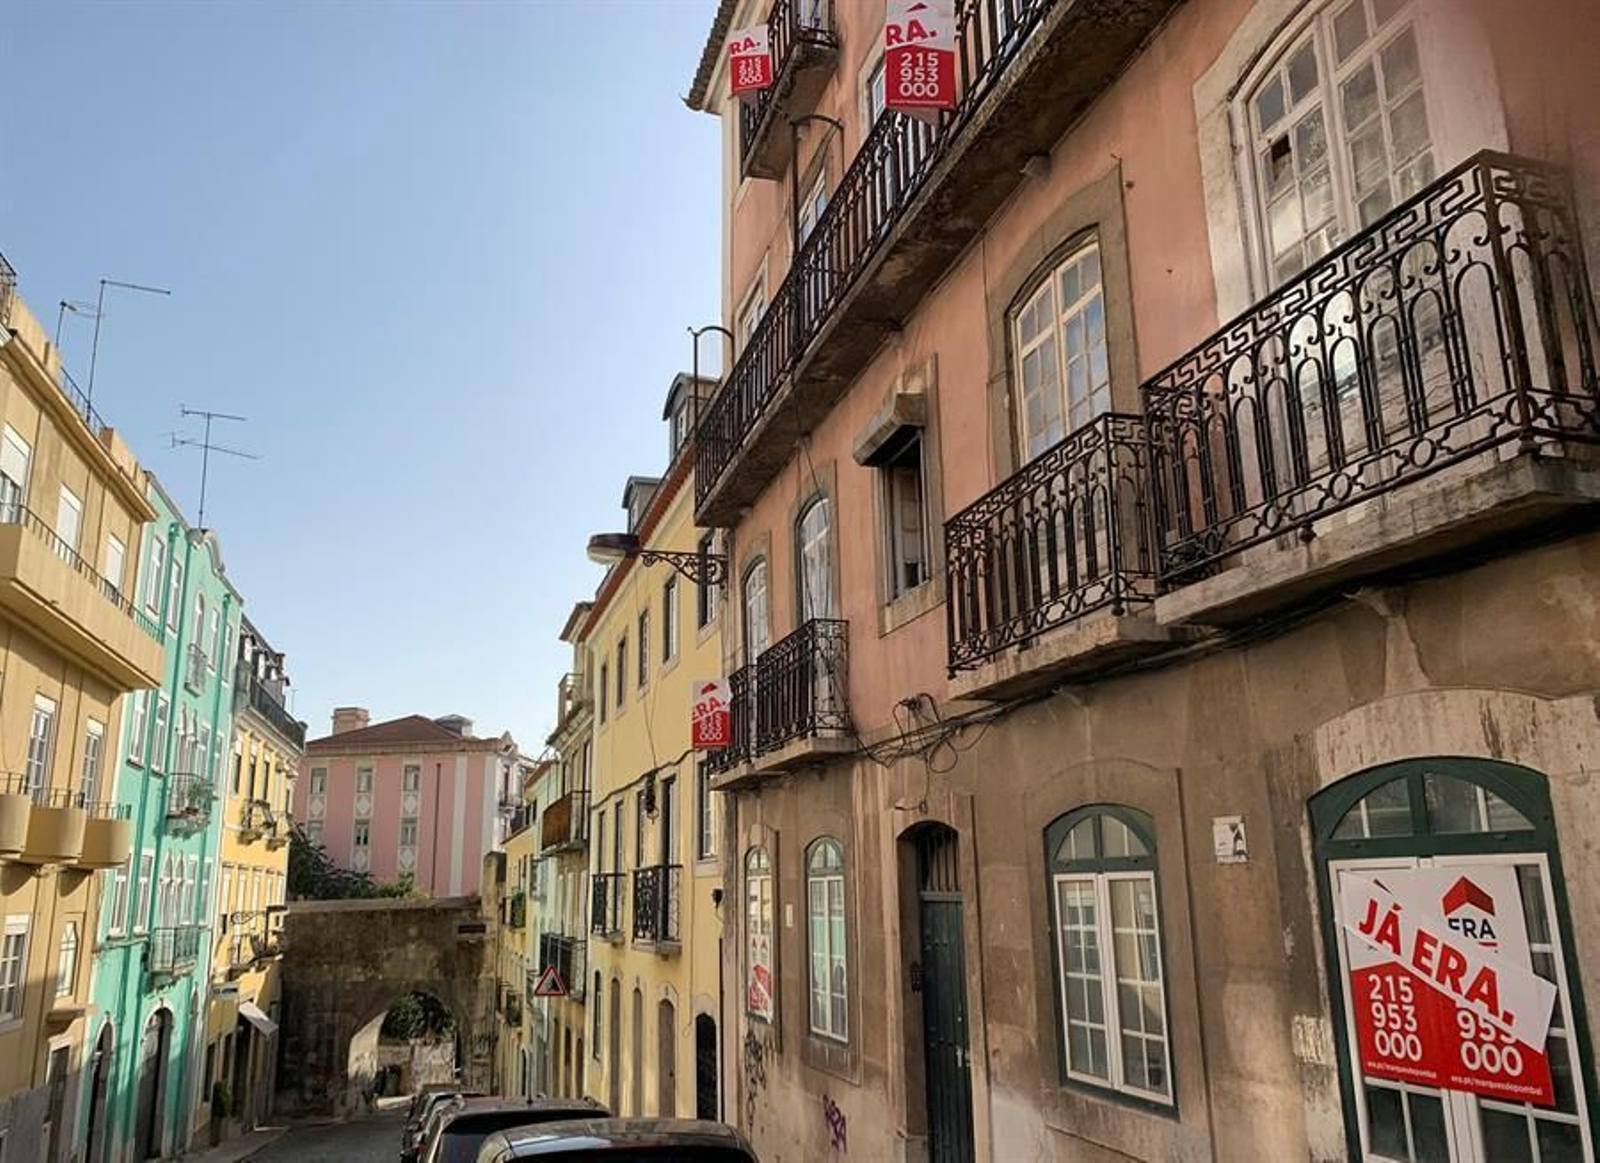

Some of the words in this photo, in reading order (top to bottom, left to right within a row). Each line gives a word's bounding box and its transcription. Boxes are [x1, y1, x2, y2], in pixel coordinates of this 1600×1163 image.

[900, 67, 939, 83] 953
[901, 52, 939, 68] 215
[900, 82, 940, 97] 000
[1359, 898, 1402, 956] JÁ
[1412, 929, 1515, 1027] ERA.
[1368, 974, 1414, 1004] 215
[1371, 1001, 1418, 1032] 953
[1375, 1028, 1423, 1062] 000
[1460, 1041, 1524, 1077] 000
